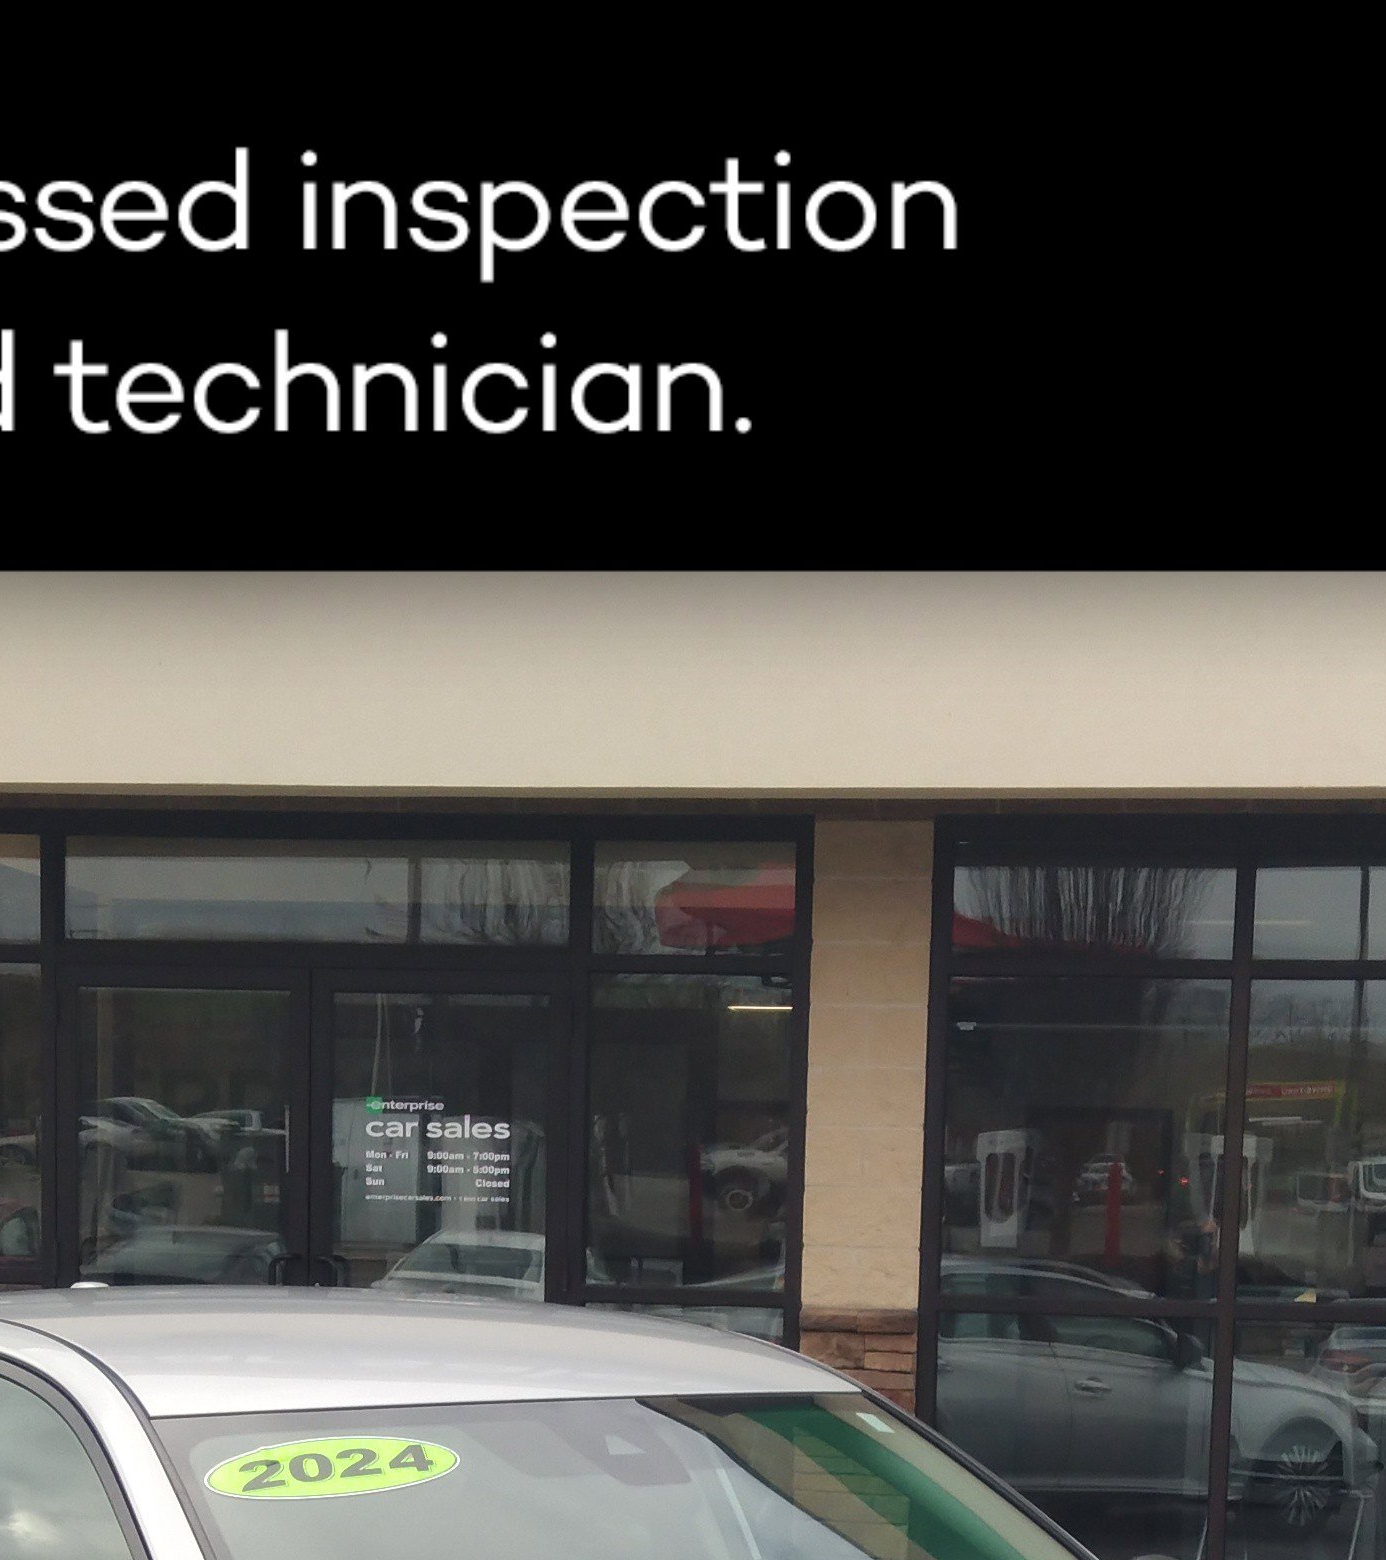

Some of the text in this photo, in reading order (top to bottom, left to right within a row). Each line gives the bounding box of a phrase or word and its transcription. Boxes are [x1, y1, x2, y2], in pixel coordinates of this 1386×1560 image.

[367, 1100, 445, 1112] enterprise
[365, 1113, 511, 1139] car sales
[365, 1150, 387, 1159] Mon
[395, 1150, 409, 1159] Fri
[365, 1163, 383, 1172] Sat
[426, 1164, 464, 1173] 9:00am
[365, 1177, 510, 1188] Sun Closed
[238, 1444, 437, 1492] 2024
